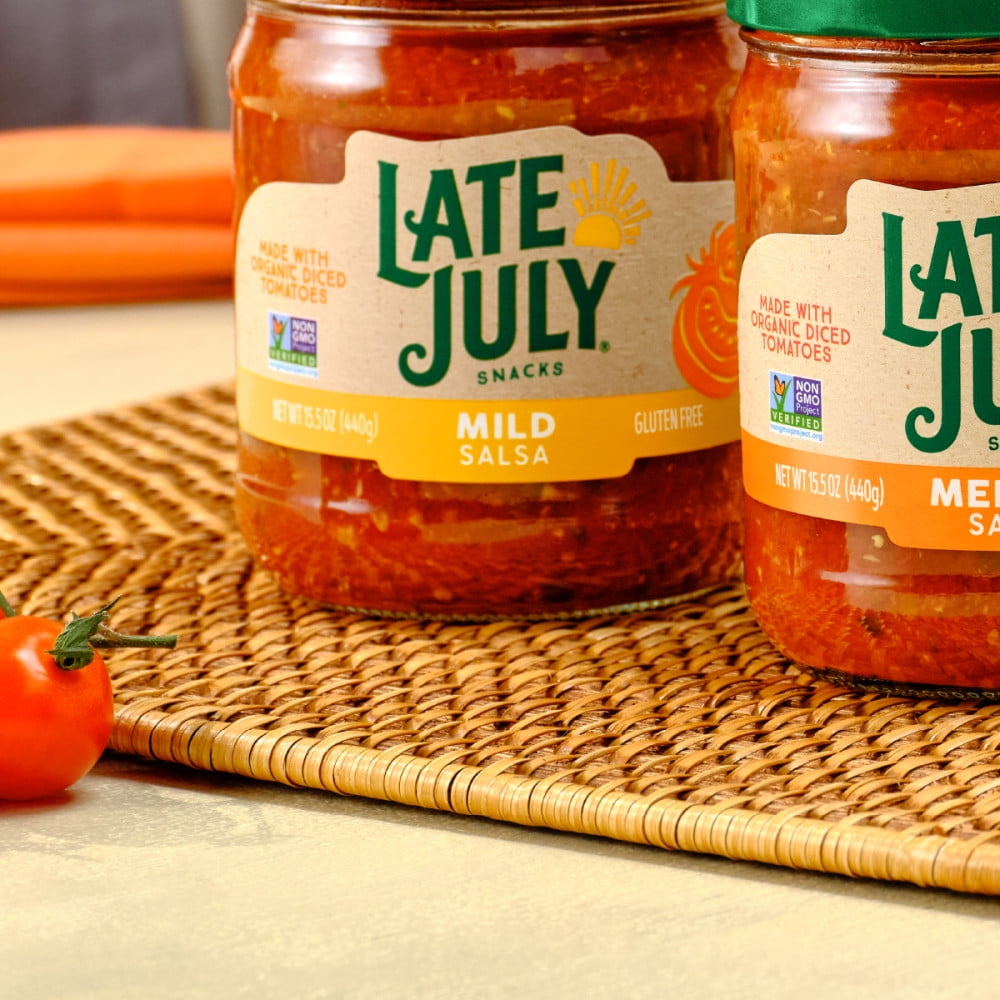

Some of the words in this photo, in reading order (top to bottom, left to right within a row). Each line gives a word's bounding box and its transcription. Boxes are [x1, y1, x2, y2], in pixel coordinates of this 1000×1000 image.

[376, 154, 566, 287] LATE
[259, 240, 288, 261] MADE
[293, 248, 329, 267] WITH
[251, 255, 297, 281] ORGANIC
[302, 266, 347, 288] DICED
[261, 276, 328, 304] TOMATOES
[398, 257, 616, 387] JULY
[760, 294, 791, 317] MADE
[796, 302, 832, 324] WITH
[292, 319, 315, 334] NON
[292, 333, 316, 345] GMO
[751, 310, 800, 338] ORGANIC
[805, 323, 851, 346] DICED
[761, 332, 832, 363] TOMATOES
[477, 361, 564, 385] SNACKS
[795, 379, 819, 395] NON
[795, 394, 820, 406] GMO
[796, 402, 820, 416] Project
[322, 407, 337, 432] OZ
[339, 407, 379, 444] (440g)
[456, 411, 556, 440] MILD
[634, 407, 679, 435] GLUTEN
[679, 404, 704, 429] FREE
[771, 410, 820, 430] VERIFIED
[459, 444, 549, 466] SALSA
[775, 461, 791, 489] NET
[791, 467, 807, 493] WT
[808, 471, 827, 497] 15.5
[826, 473, 842, 500] OZ
[844, 474, 885, 512] (440g)
